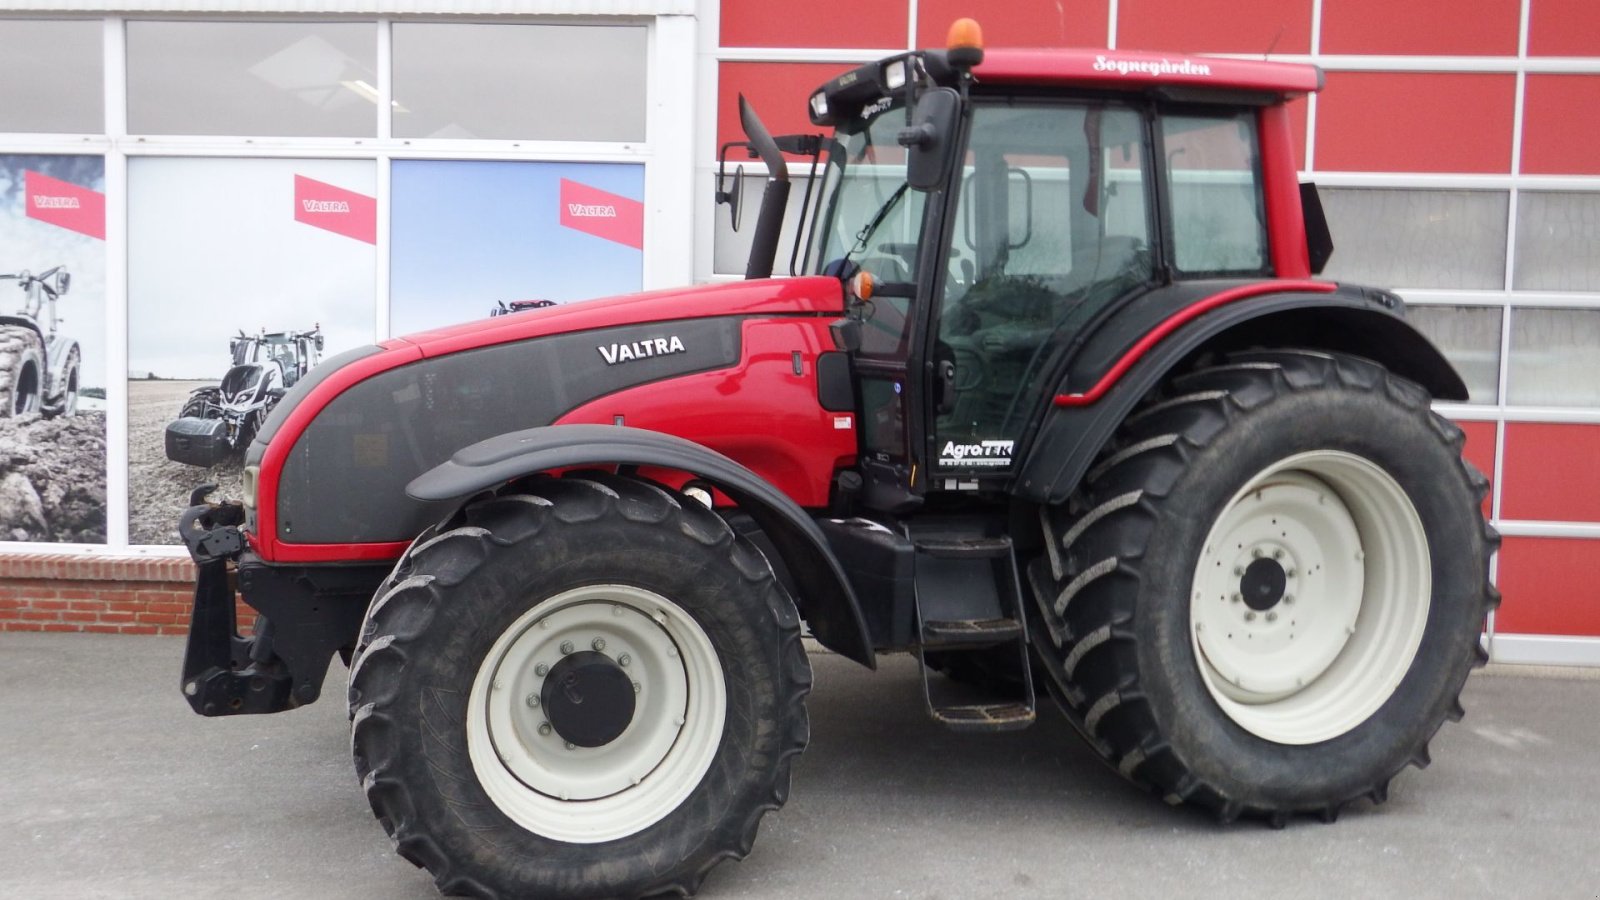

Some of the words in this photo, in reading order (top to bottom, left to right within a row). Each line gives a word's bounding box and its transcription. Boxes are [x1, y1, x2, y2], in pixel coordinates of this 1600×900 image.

[33, 195, 80, 208] VALTRA
[303, 200, 350, 212] VALTRA
[568, 204, 616, 217] VALTRA
[598, 336, 686, 365] VALTRA
